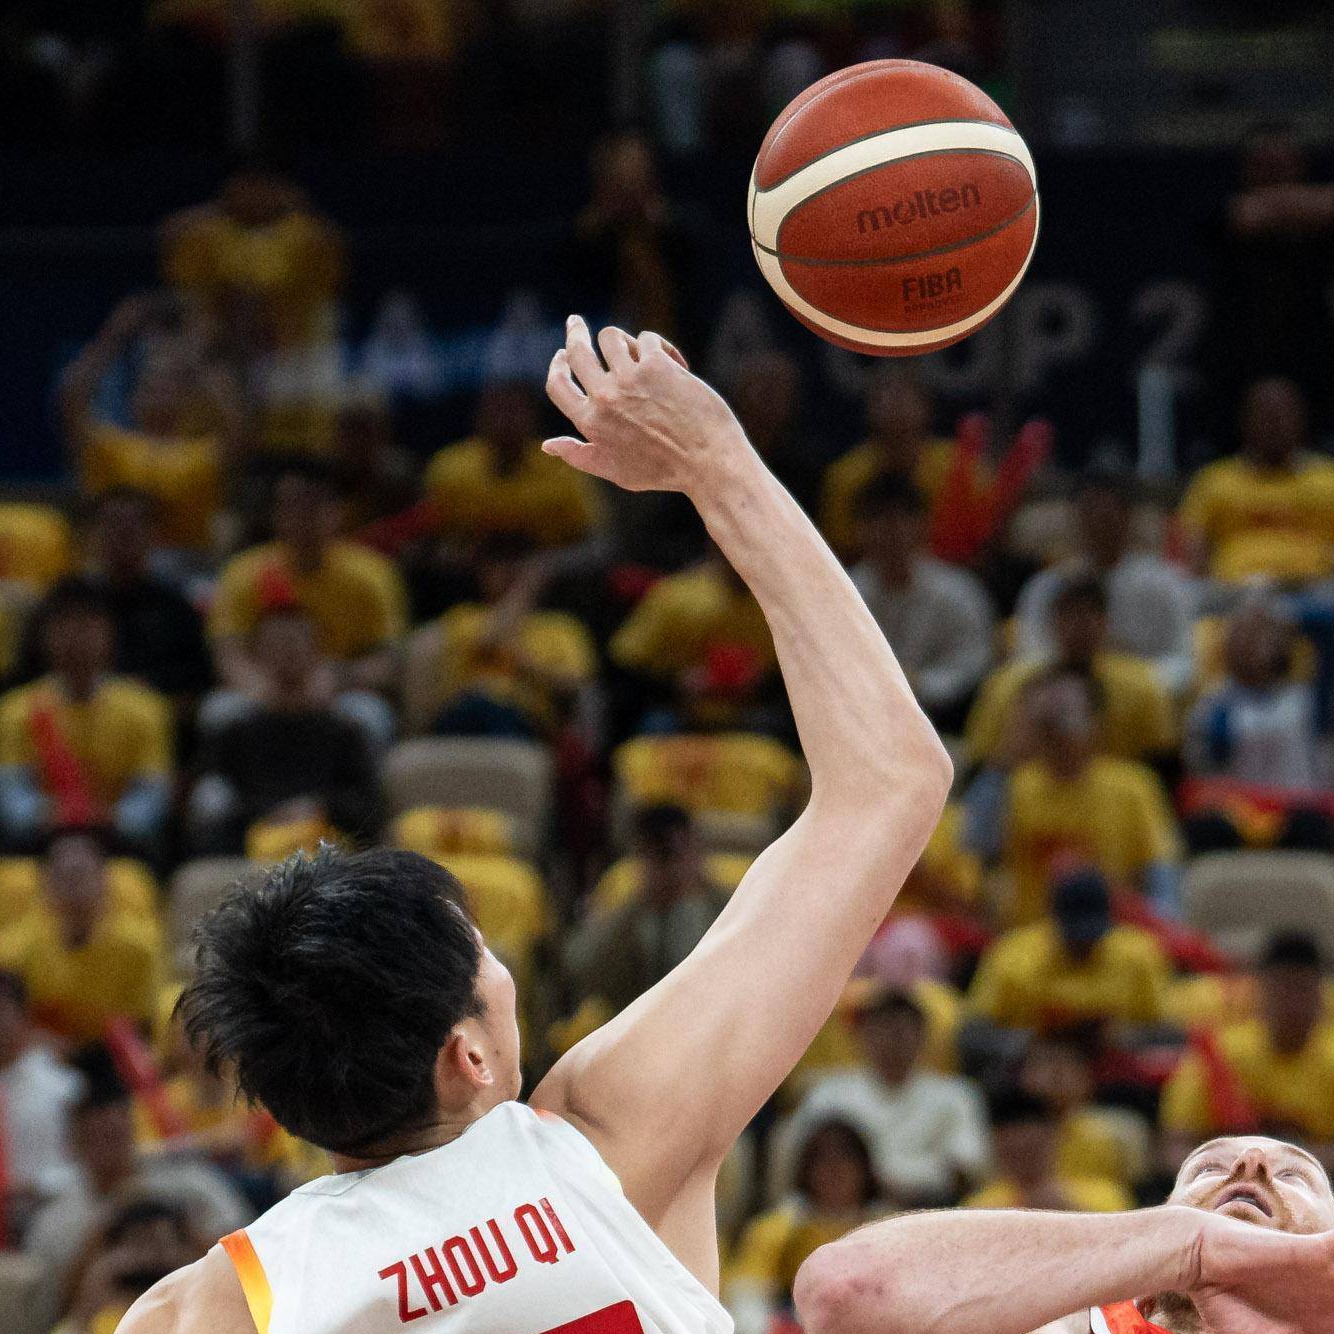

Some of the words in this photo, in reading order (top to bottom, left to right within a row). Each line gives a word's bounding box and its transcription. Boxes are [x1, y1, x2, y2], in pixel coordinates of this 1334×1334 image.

[855, 184, 982, 234] molten
[901, 267, 963, 300] FIBA
[378, 1219, 519, 1324] ZHOU
[514, 1197, 577, 1265] QI
